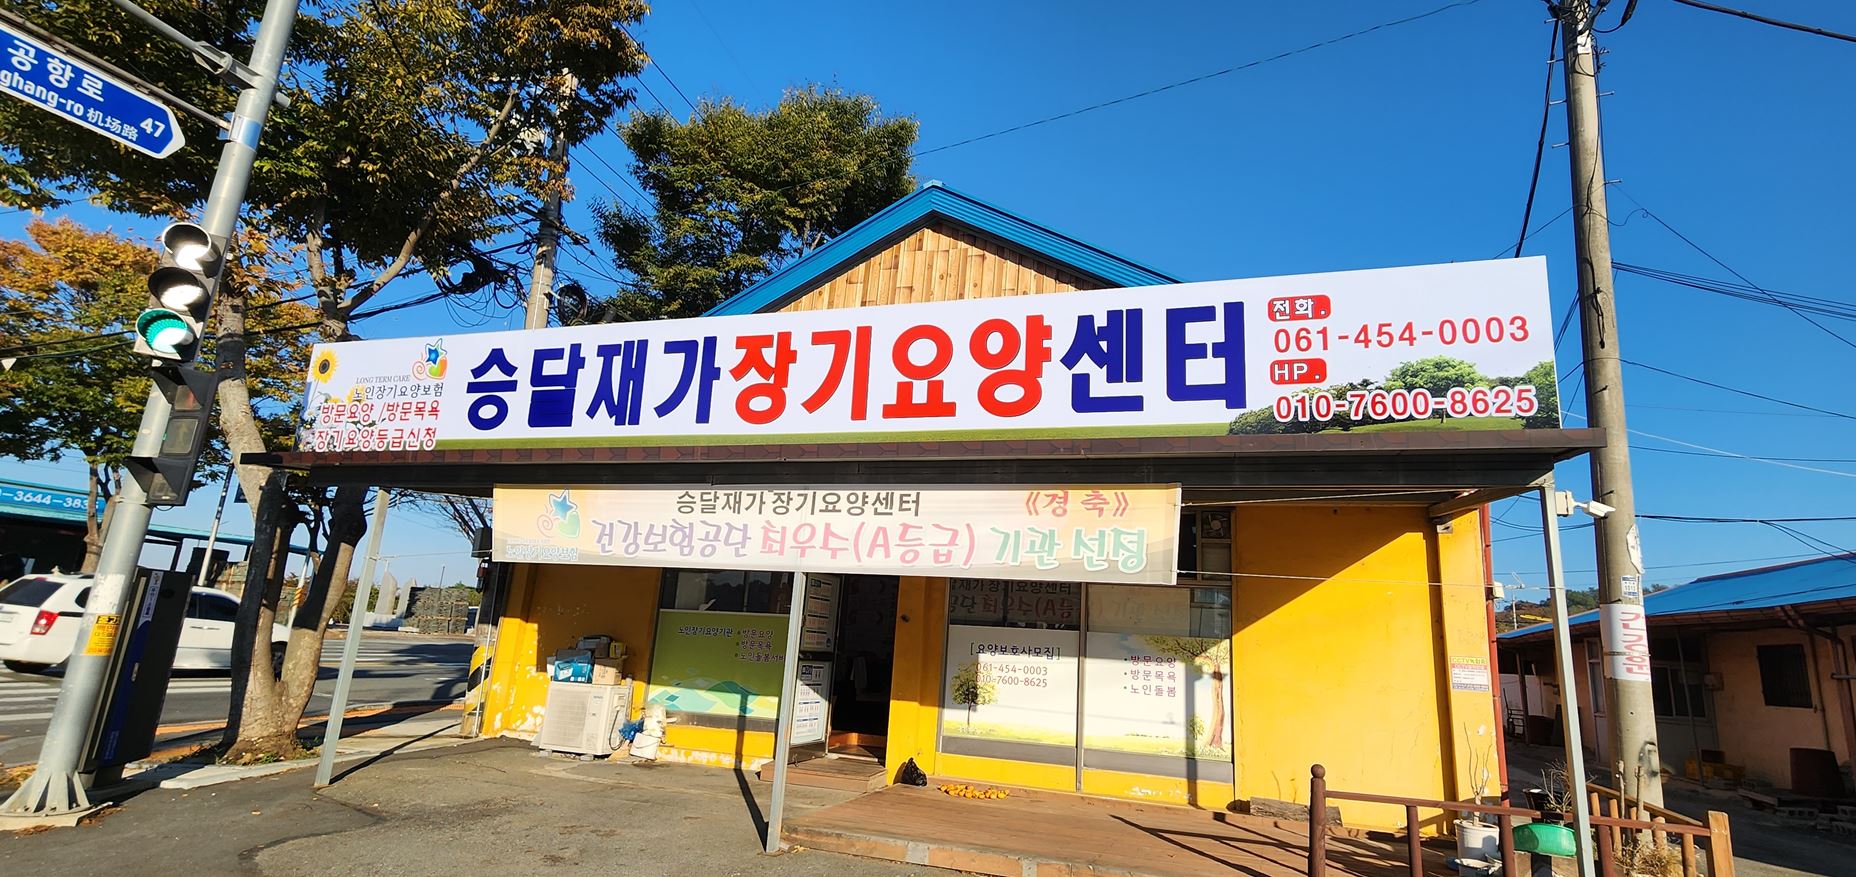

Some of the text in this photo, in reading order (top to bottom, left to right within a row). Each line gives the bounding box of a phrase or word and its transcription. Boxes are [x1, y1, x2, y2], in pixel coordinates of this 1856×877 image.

[7, 39, 105, 103] 공항로
[87, 107, 139, 142] 机场路
[139, 117, 166, 139] 47
[1273, 315, 1530, 353] 061-454-0003
[392, 374, 411, 382] CARE
[353, 382, 444, 400] 노인장기요양보험
[320, 401, 374, 424] 방문요양
[1275, 387, 1536, 421] 010-7600-8625
[315, 427, 437, 451] 장기요양등급신청
[0, 489, 99, 510] -3644-383
[591, 519, 1148, 572] 건강보험공단 최우수(A등급) 기관 선정
[975, 662, 1048, 676] 061-454-0003
[1130, 669, 1177, 683] 방문목욕
[975, 674, 1048, 688] 010-7600-8625
[1130, 684, 1177, 698] 노인돌봄
